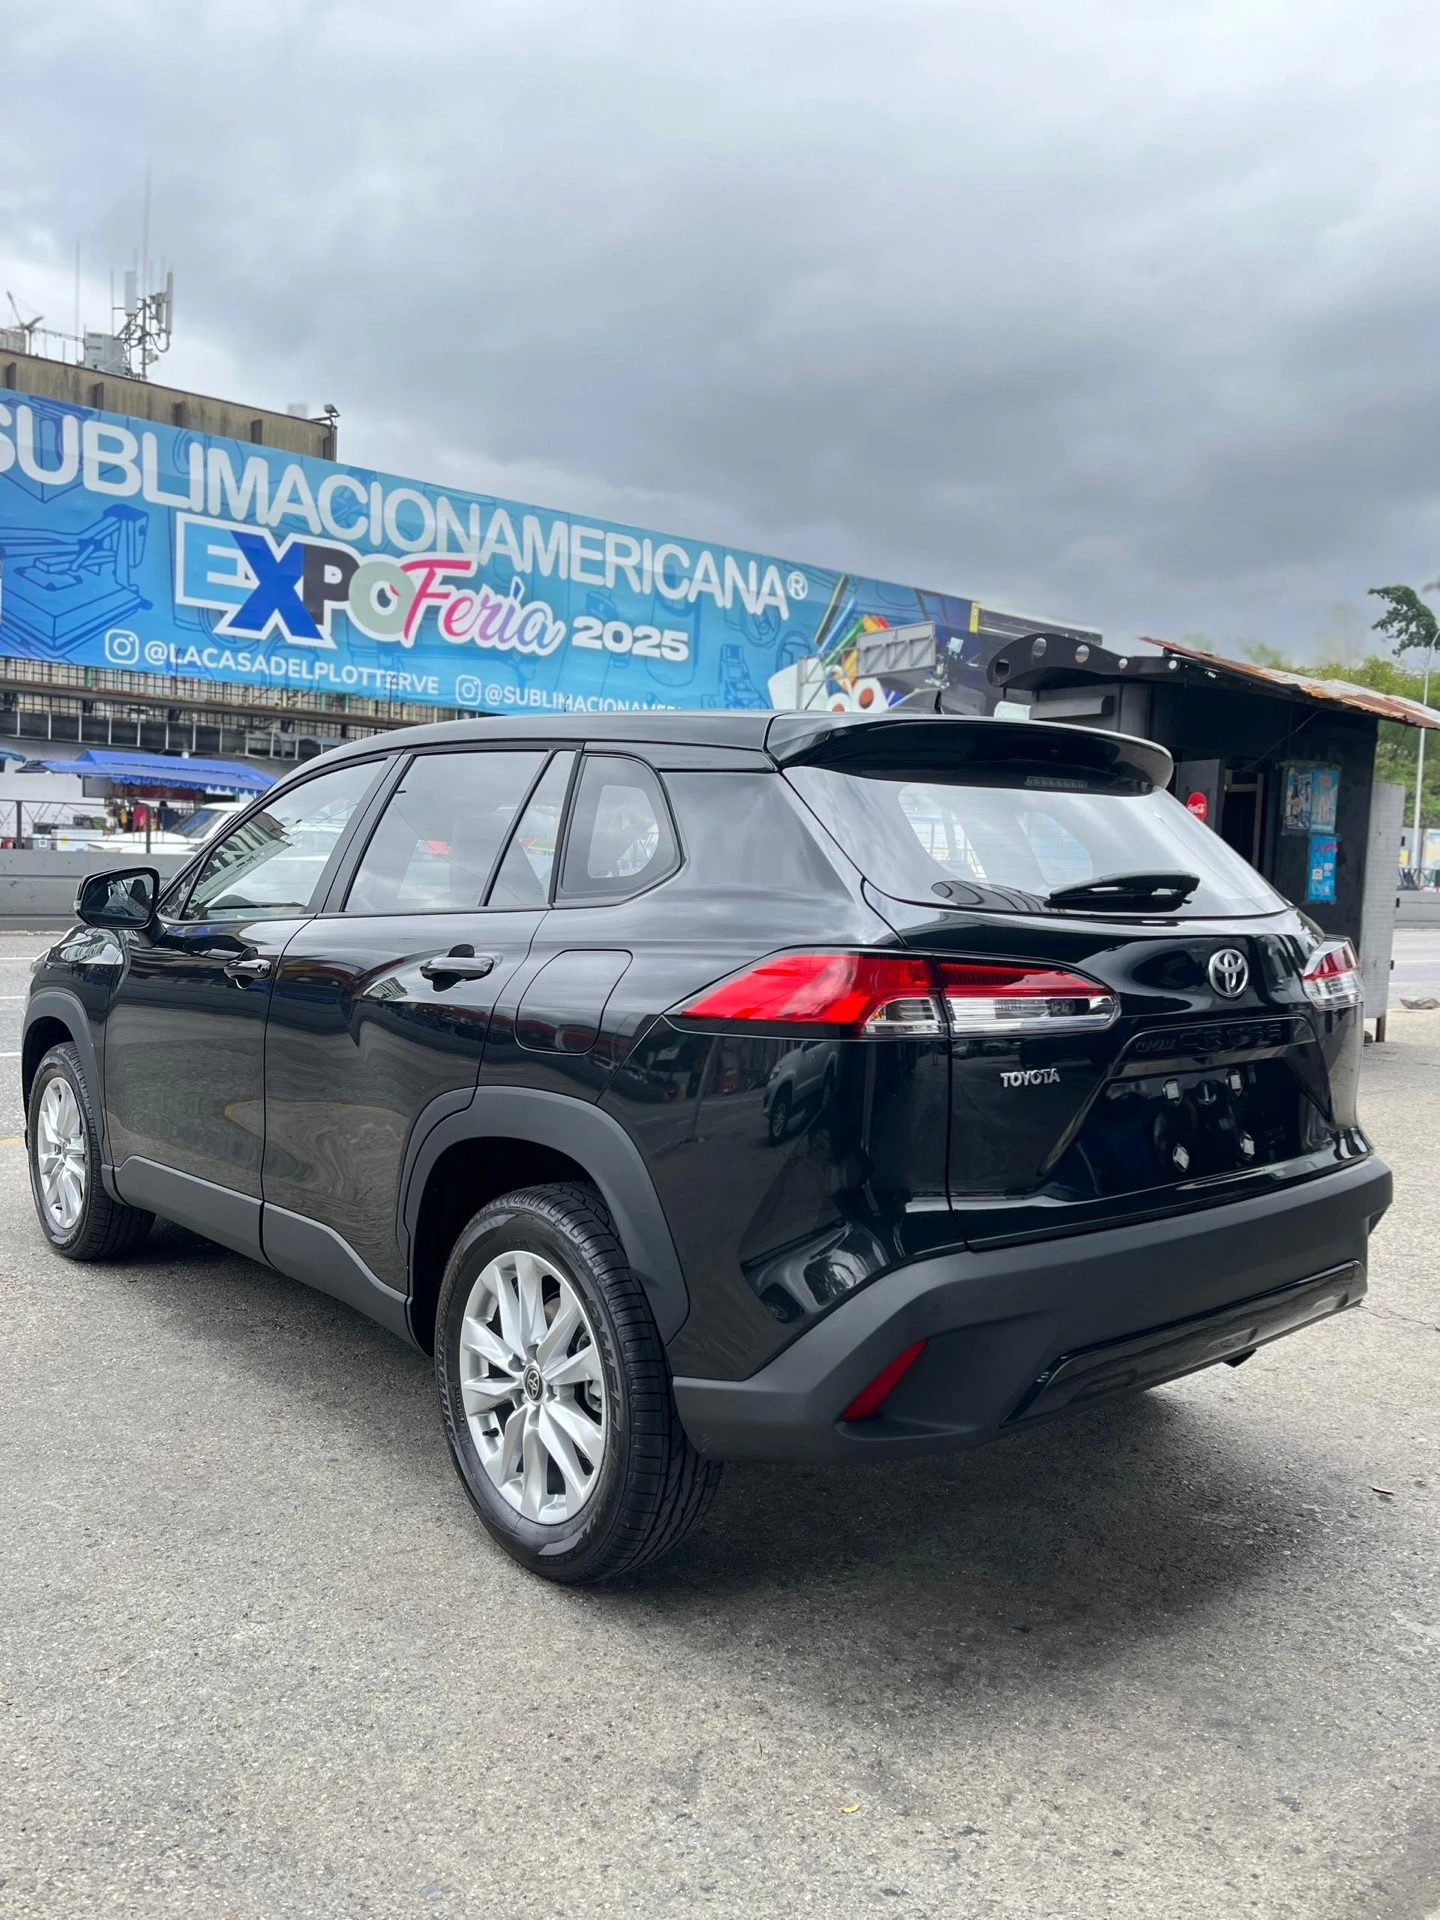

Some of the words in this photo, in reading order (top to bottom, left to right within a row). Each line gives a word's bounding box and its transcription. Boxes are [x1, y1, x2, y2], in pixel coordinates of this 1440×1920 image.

[176, 513, 416, 648] EXPO
[388, 553, 566, 655] Feria
[572, 616, 690, 661] 2025
[144, 640, 439, 695] @LACASADELPLOTTERVE
[1000, 1068, 1060, 1088] TOYOTA
